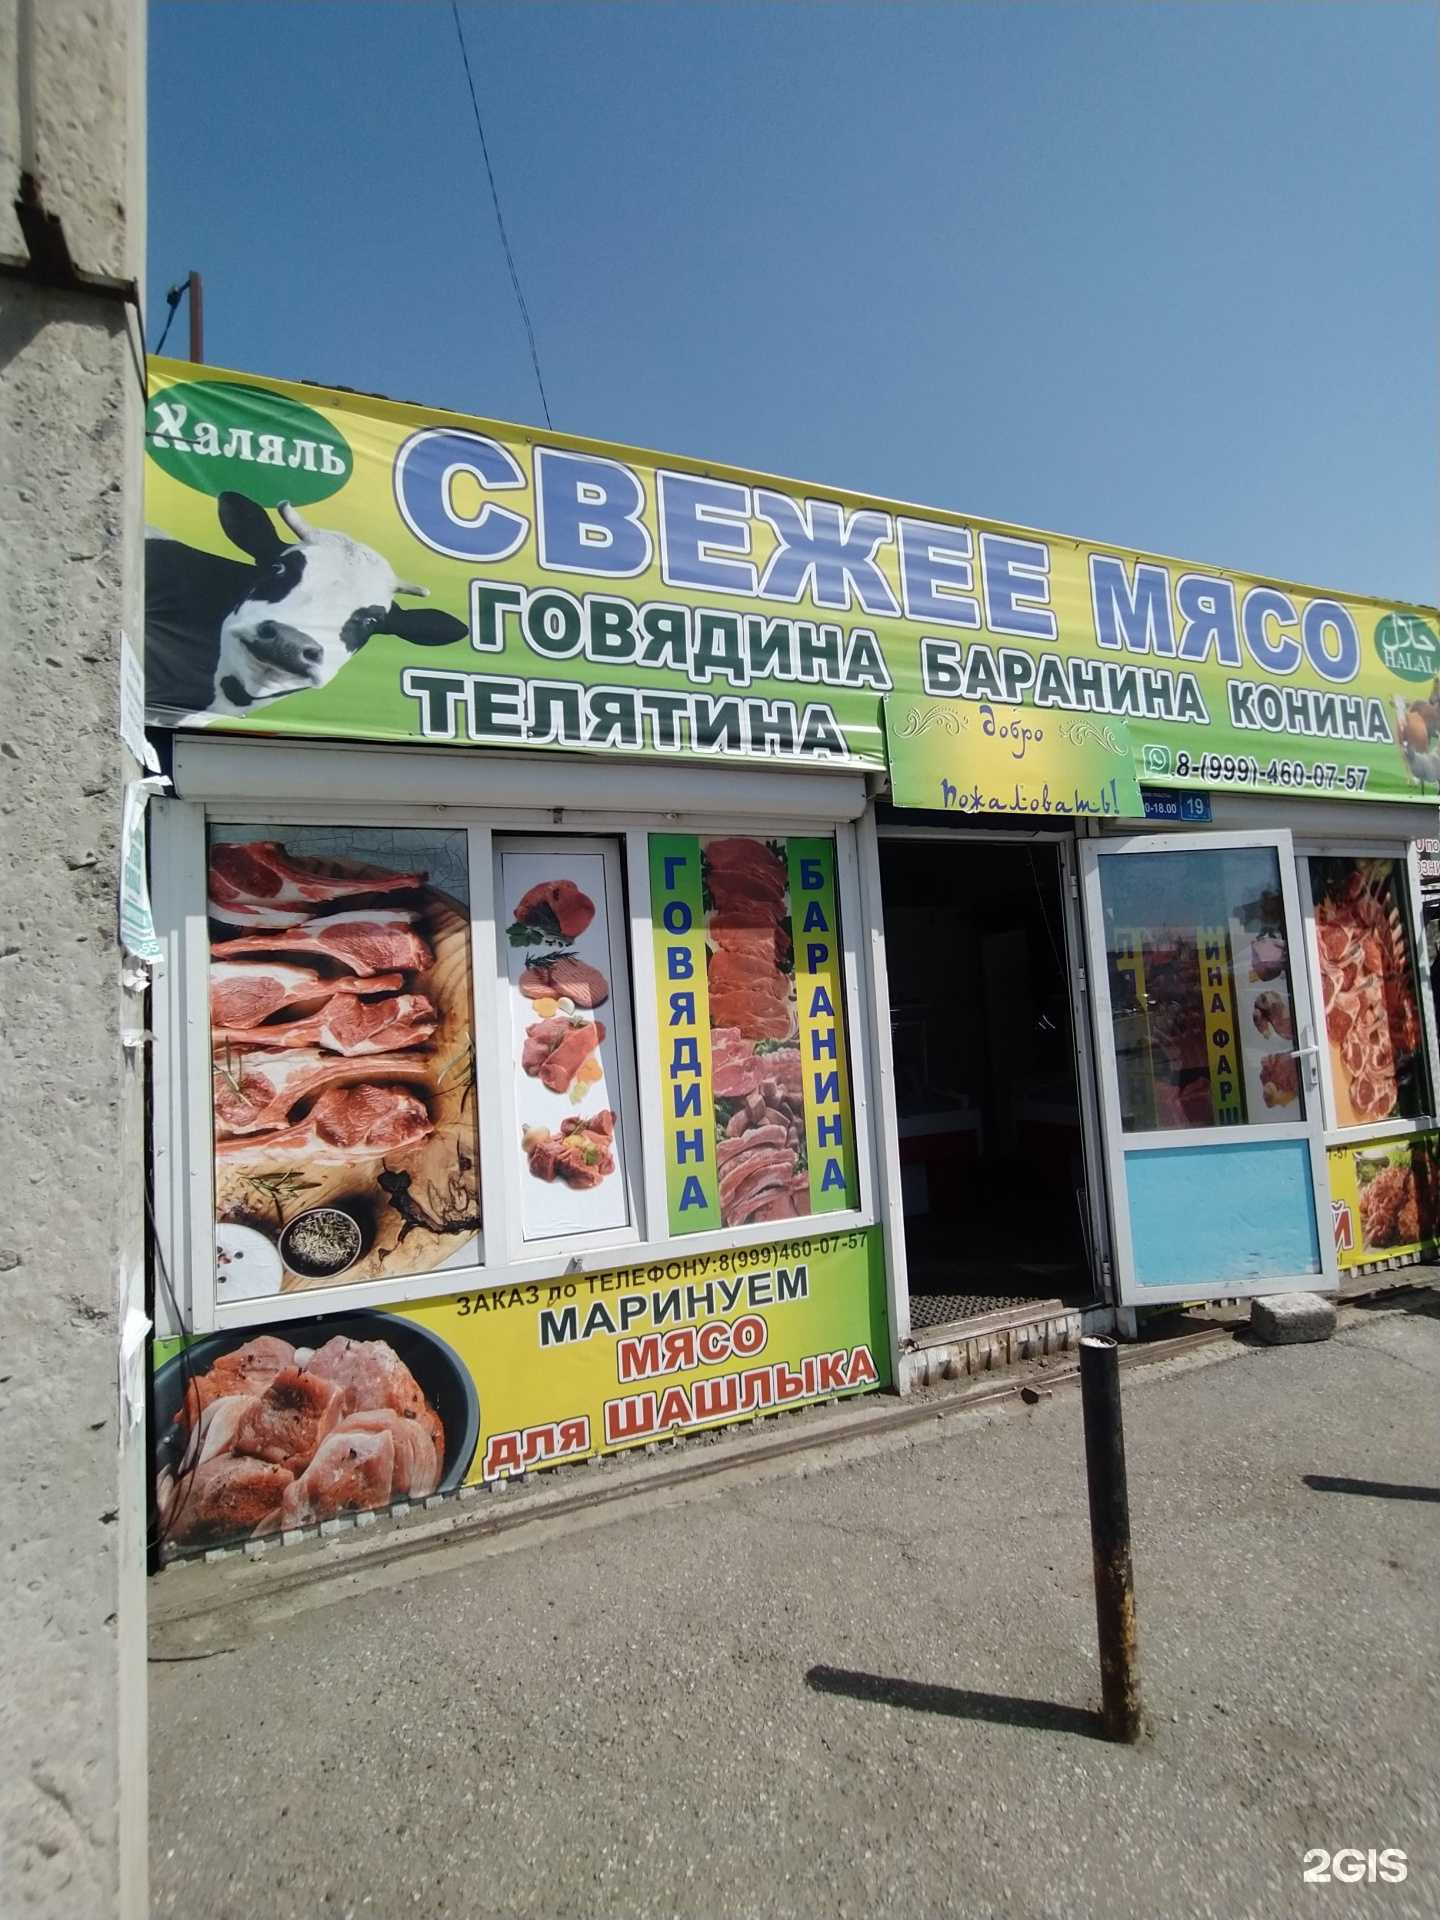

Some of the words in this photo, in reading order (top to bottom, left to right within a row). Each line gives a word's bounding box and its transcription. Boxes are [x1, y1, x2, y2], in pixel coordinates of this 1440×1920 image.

[152, 402, 346, 475] Халяль
[393, 426, 1058, 641] СВЕЖЕЕ
[1088, 553, 1360, 684] МЯСО
[469, 579, 893, 690] ГОВЯДИНА
[921, 637, 1210, 725] БАРАНИНА
[1227, 678, 1395, 744] КОНИНА
[1384, 648, 1438, 674] HALAL
[401, 668, 851, 761] ТЕЛЯТИНА
[1176, 752, 1368, 792] 8-(999)-460-07-57
[1186, 798, 1204, 815] 19
[663, 856, 709, 1213] ГОВЯДИНА
[800, 858, 847, 1193] БАРАНИНА
[1213, 1028, 1239, 1124] ФАРШ
[457, 1284, 539, 1316] ЗАКАЗ
[549, 1282, 577, 1304] по
[538, 1264, 810, 1348] МАРИНУЕМ
[617, 1314, 768, 1384] МЯСО
[483, 1415, 591, 1481] ДЛЯ
[603, 1344, 879, 1444] ШАШЛЫКА
